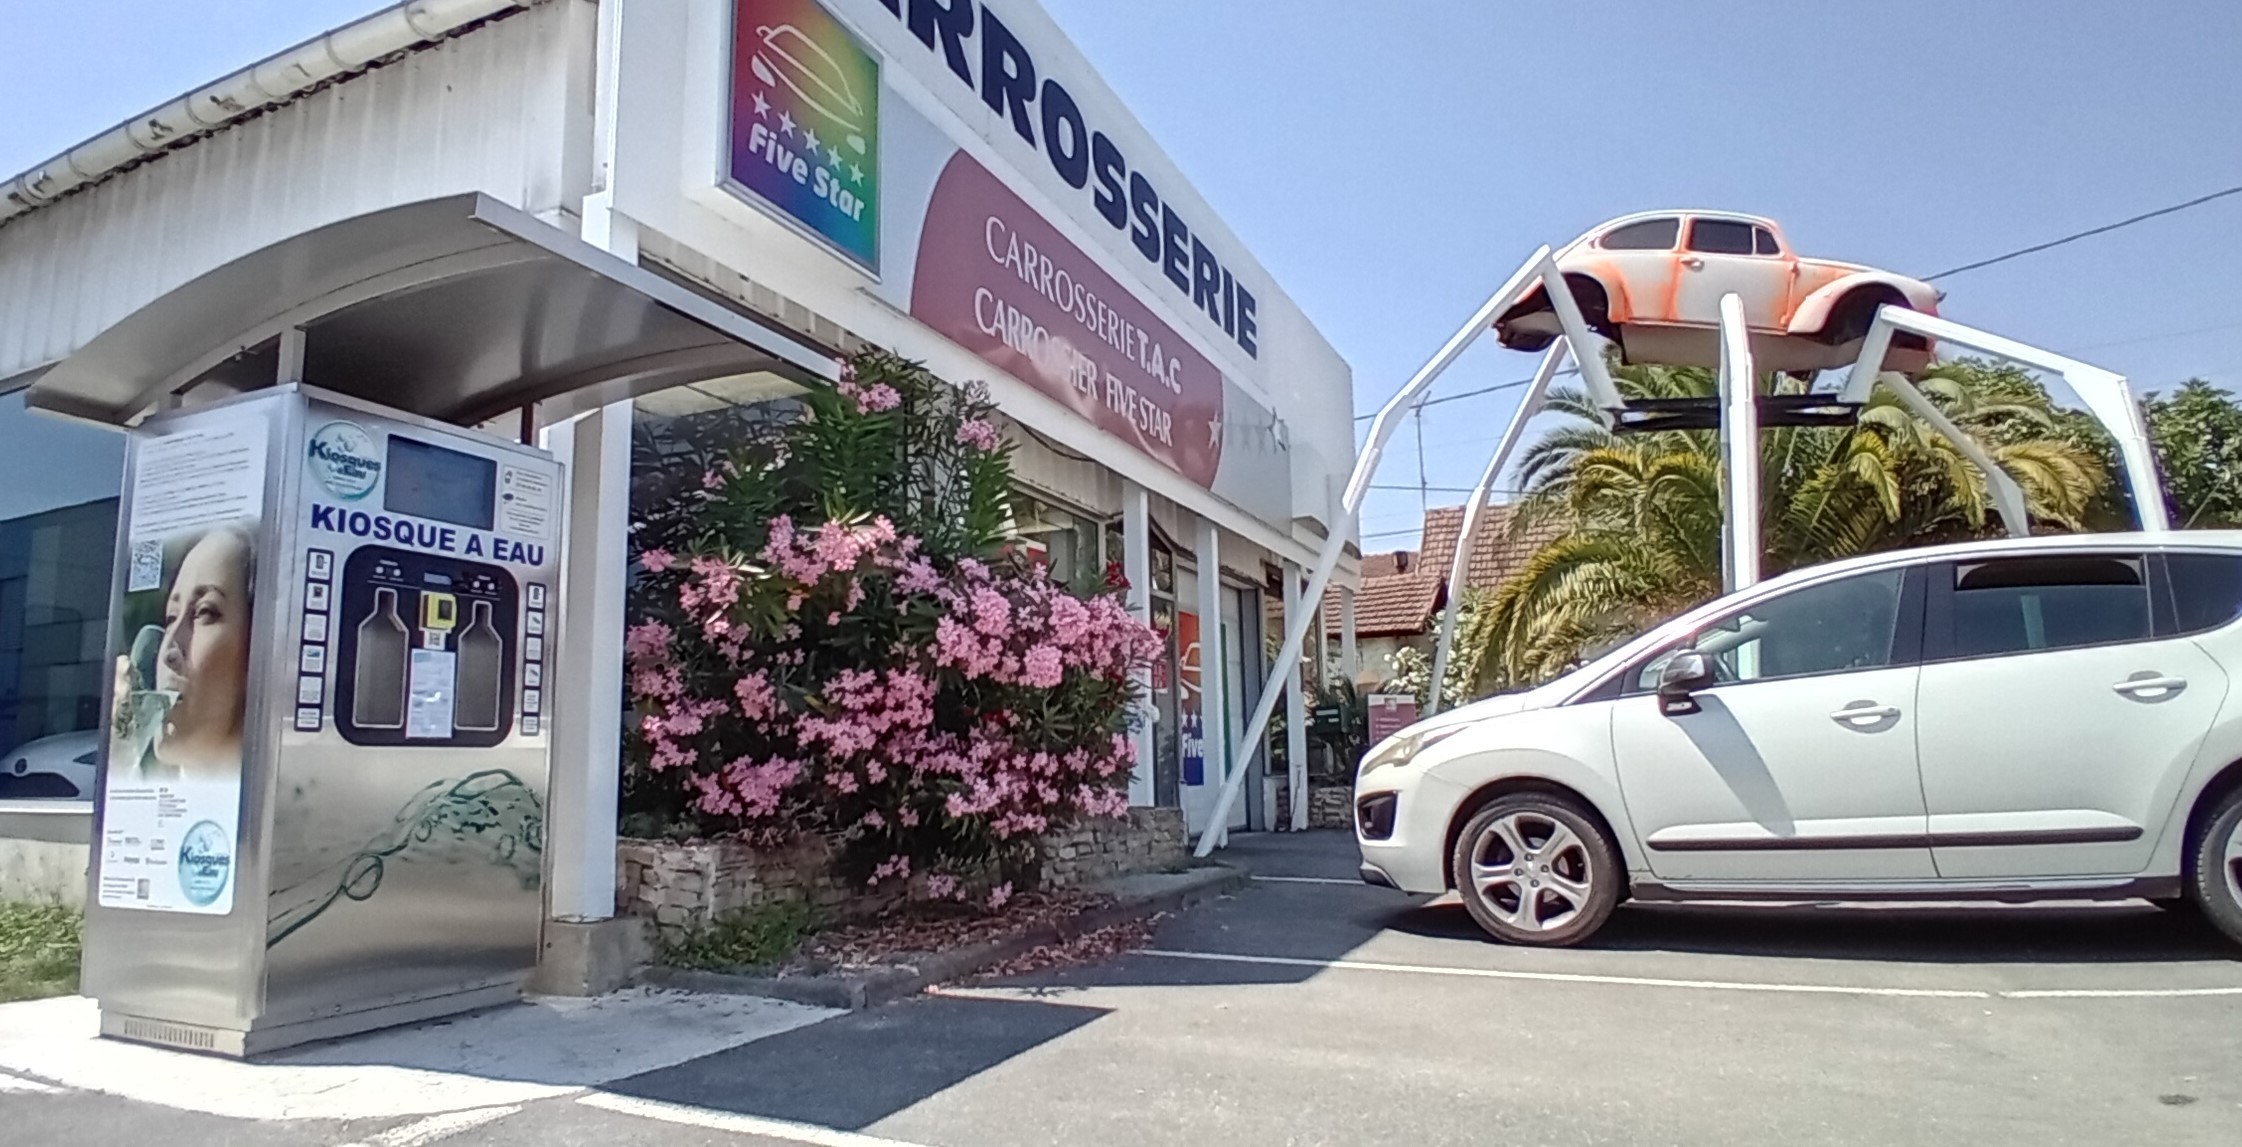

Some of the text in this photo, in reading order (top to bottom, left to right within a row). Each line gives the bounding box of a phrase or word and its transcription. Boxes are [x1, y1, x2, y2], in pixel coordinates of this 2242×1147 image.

[748, 121, 865, 222] Five Star
[878, 0, 1258, 360] RROSSERIE
[984, 215, 1136, 363] CARROSSERIE
[1105, 371, 1137, 425] FIVE
[1138, 396, 1174, 448] STAR
[308, 438, 382, 473] Kiosques
[310, 503, 544, 567] KIOSQUE A EAU
[1182, 732, 1204, 759] Five
